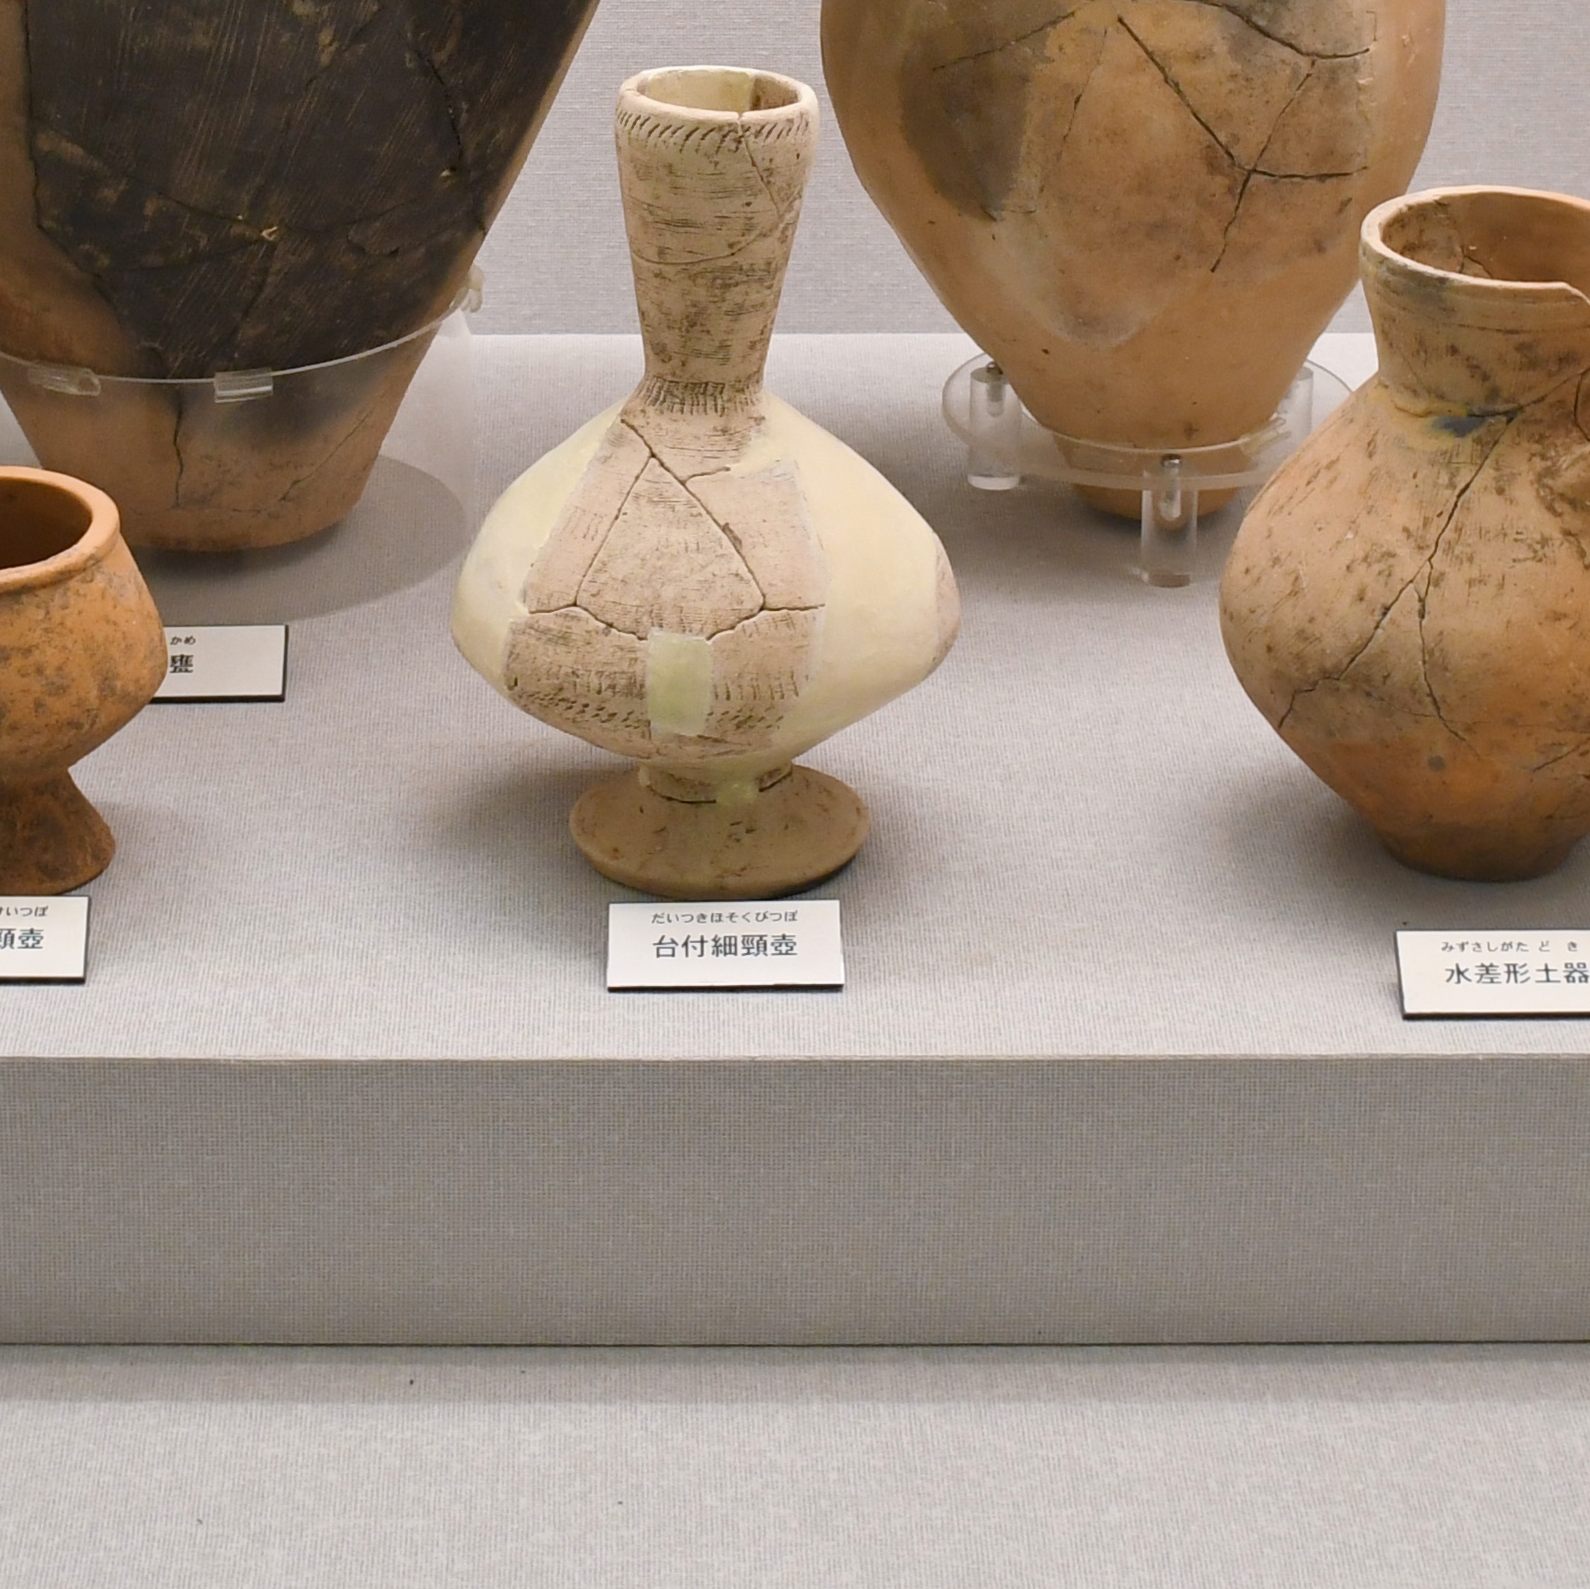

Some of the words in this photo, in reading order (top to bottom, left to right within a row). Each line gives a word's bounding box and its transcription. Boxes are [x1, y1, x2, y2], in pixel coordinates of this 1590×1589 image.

[1445, 962, 1590, 985] 水差形土器
